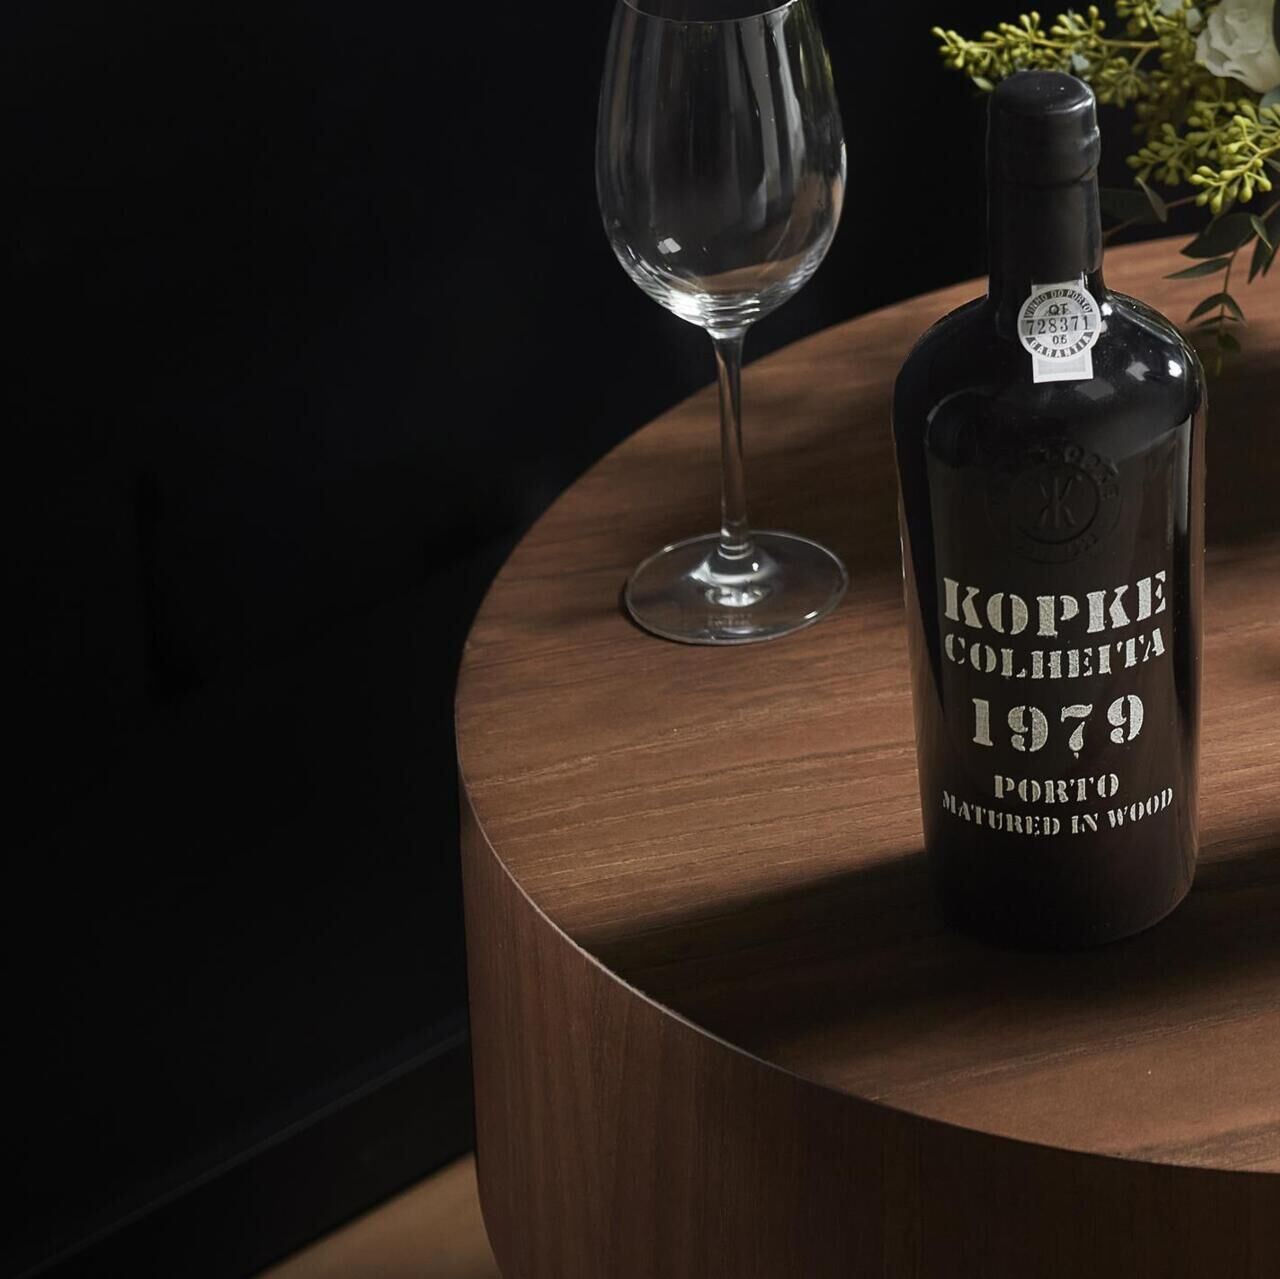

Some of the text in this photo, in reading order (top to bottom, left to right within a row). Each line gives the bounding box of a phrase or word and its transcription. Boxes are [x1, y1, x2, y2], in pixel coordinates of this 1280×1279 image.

[1026, 315, 1089, 336] 728371
[943, 570, 1167, 637] KOPKE
[944, 627, 1166, 680] COLHEITA
[971, 694, 1145, 760] 1979
[941, 787, 1174, 836] MATURED IN WOOD
[993, 773, 1120, 804] PORTO
